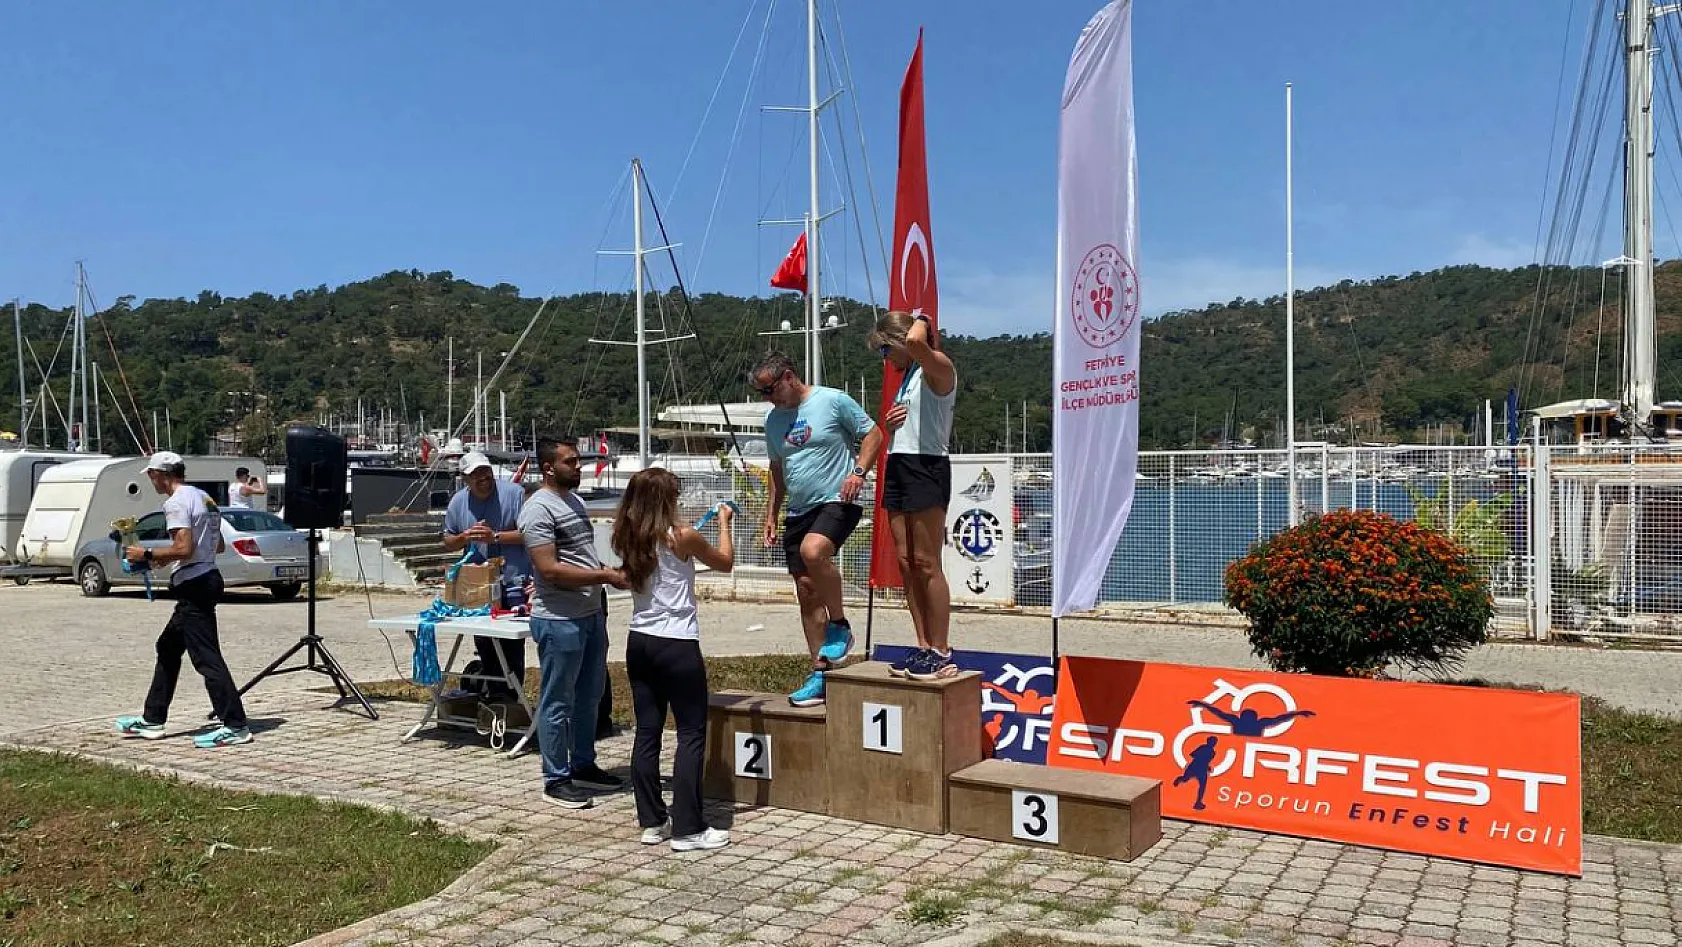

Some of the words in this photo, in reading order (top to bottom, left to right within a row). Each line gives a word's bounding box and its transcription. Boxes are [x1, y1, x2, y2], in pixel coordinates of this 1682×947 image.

[1102, 375, 1118, 387] VE
[1061, 397, 1084, 411] İLÇE
[872, 708, 888, 747] 1
[743, 737, 764, 774] 2
[1059, 722, 1567, 813] SPORFEST
[1023, 795, 1048, 836] 3
[1217, 785, 1331, 815] Sporun
[1348, 802, 1469, 834] EnFest
[1489, 820, 1567, 847] Hali
